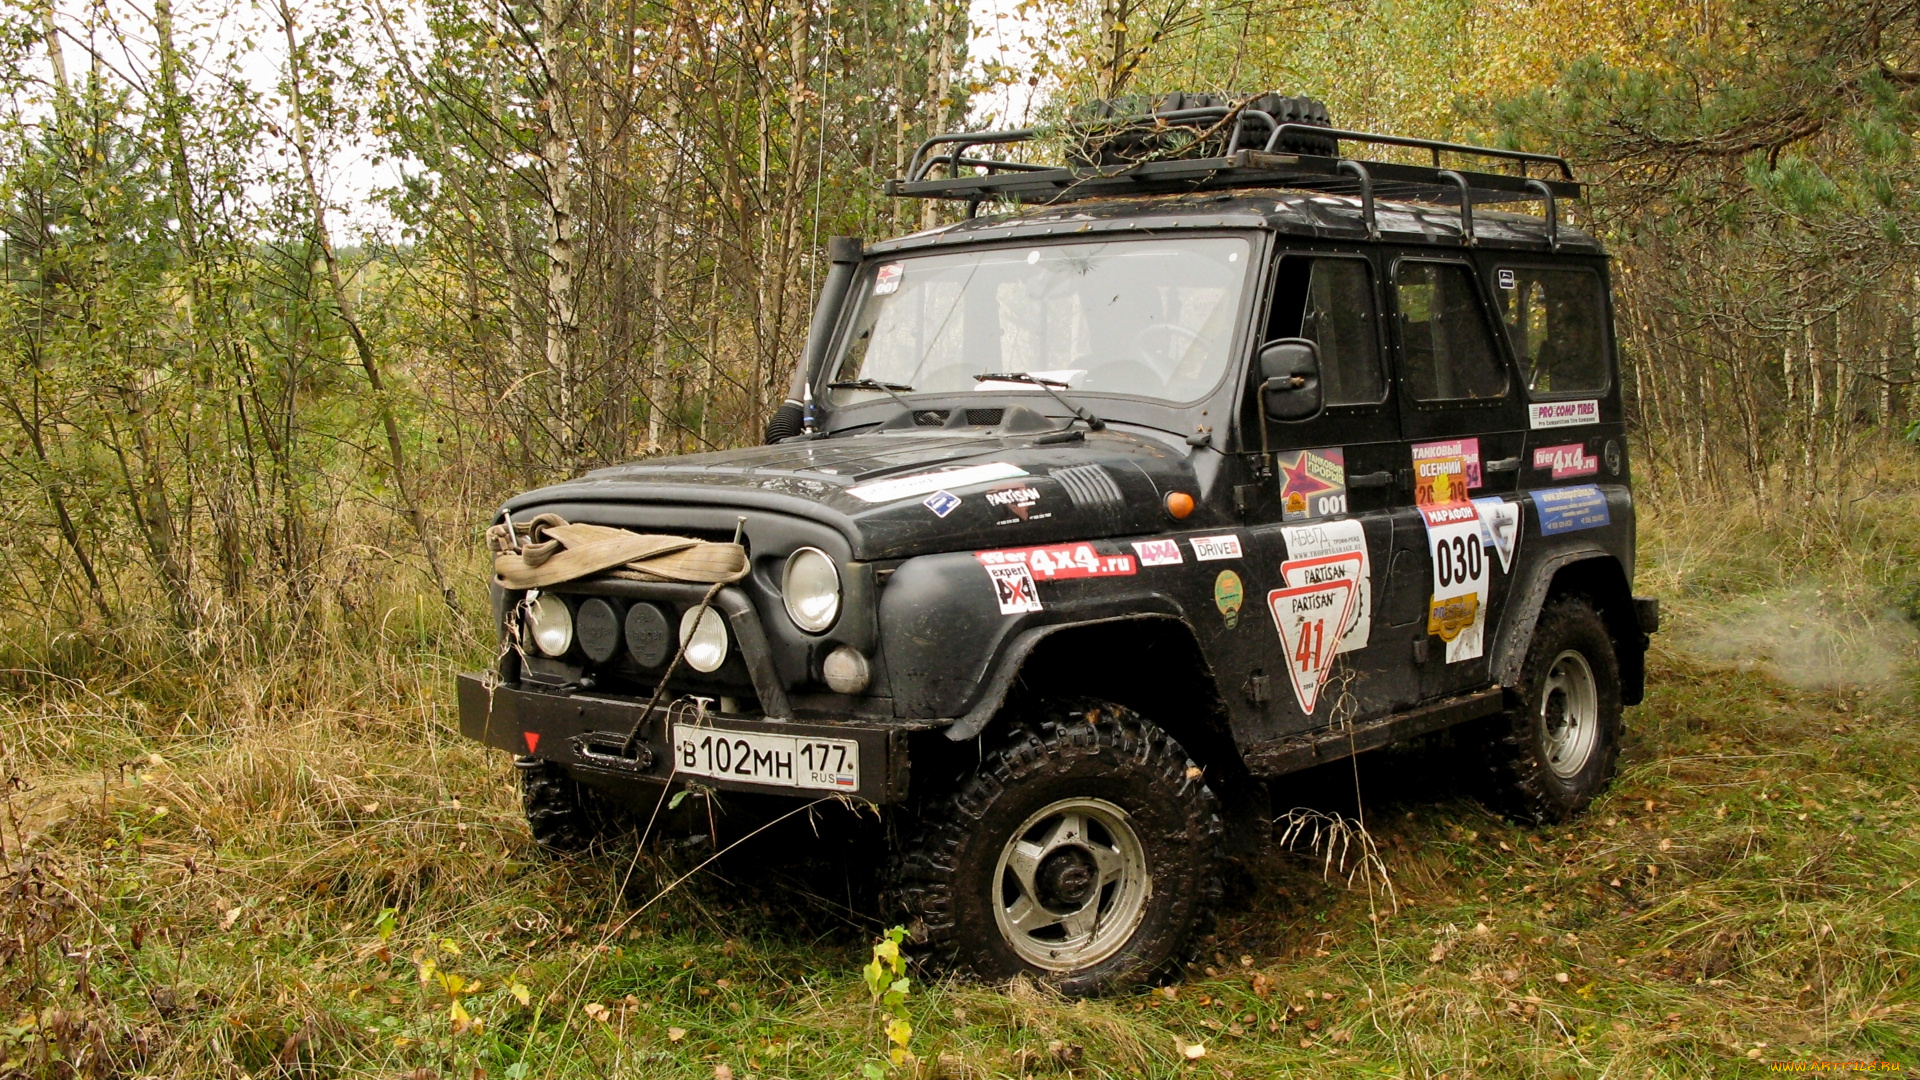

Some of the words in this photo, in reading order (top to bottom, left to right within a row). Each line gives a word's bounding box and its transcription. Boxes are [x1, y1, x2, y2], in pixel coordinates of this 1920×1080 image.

[875, 281, 898, 294] 001
[1538, 406, 1553, 419] PRO
[1556, 404, 1575, 417] COMP
[1577, 403, 1595, 415] TIRES
[1412, 441, 1462, 459] ТАНКОВЫЙ
[1308, 461, 1344, 485] ПРОРЫВ
[1419, 459, 1461, 477] ОСЕННИЙ
[1318, 494, 1347, 515] 001
[1428, 506, 1474, 523] МАРАФОН
[1437, 533, 1482, 588] 030
[991, 566, 1027, 578] expert
[1295, 618, 1324, 672] 41
[800, 743, 847, 773] 177
[811, 772, 835, 784] RUS
